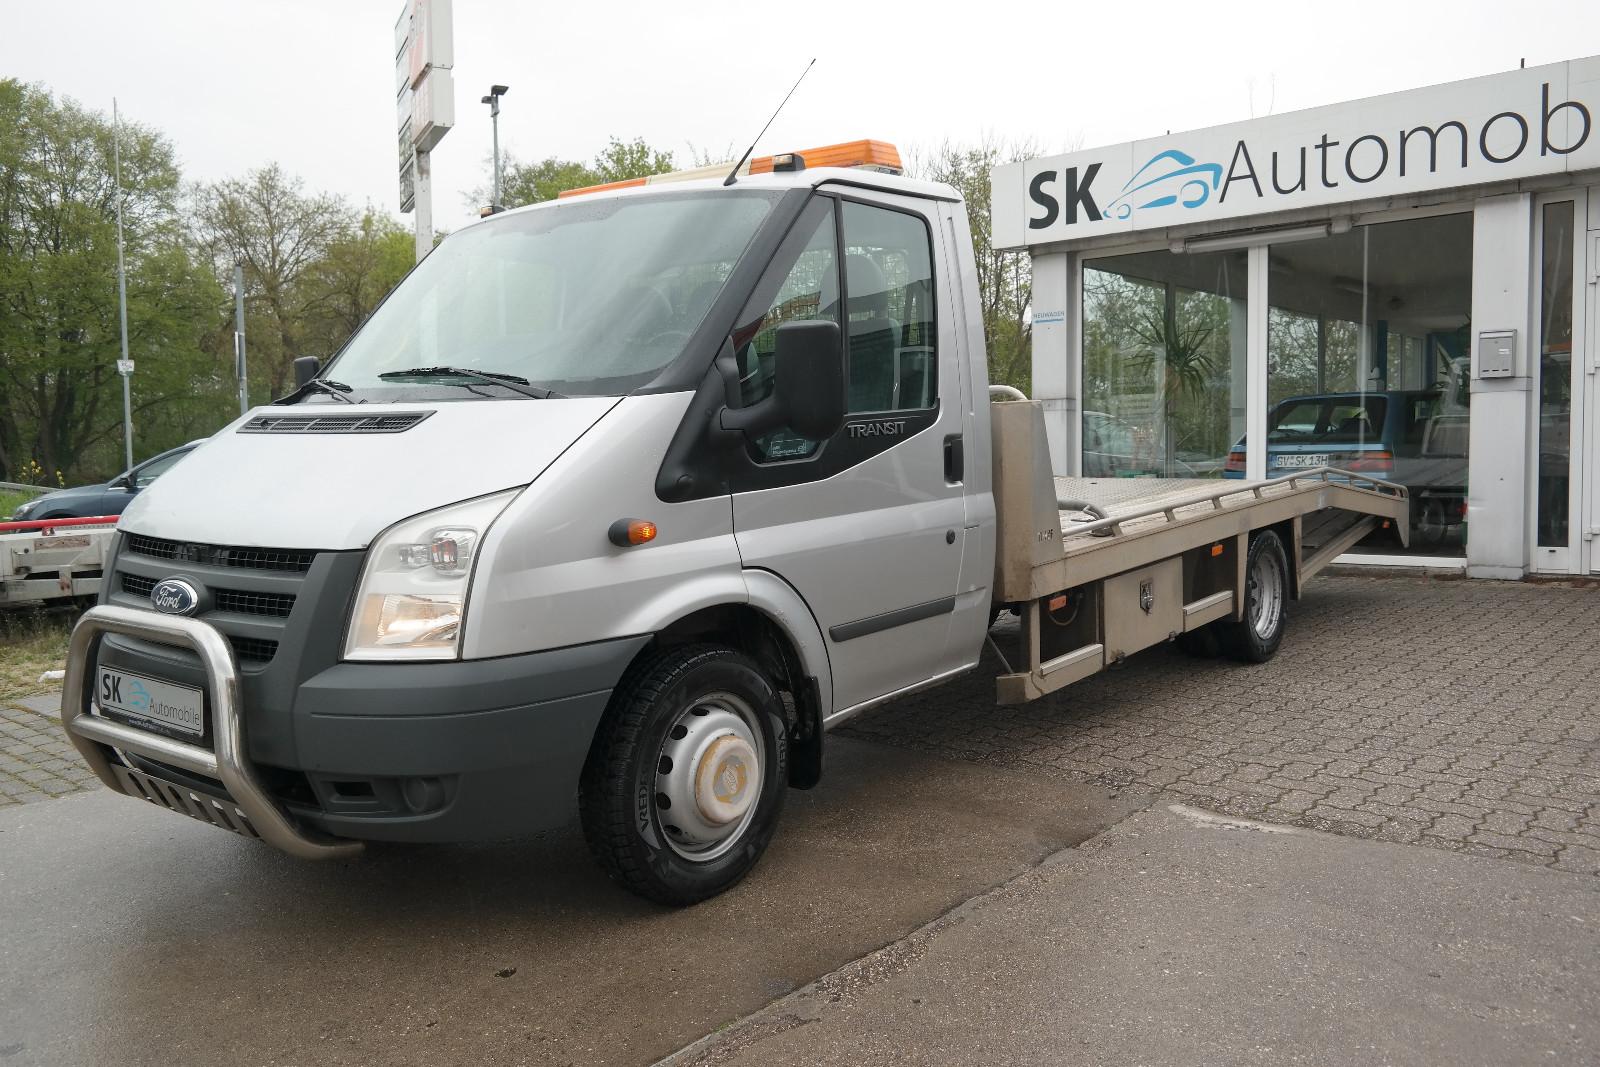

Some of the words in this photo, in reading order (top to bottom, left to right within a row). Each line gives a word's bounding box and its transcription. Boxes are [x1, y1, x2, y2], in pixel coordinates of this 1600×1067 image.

[1028, 162, 1103, 230] SK
[1219, 82, 1592, 204] Automob
[1033, 311, 1065, 319] NEUWAGEN
[847, 421, 906, 438] TRANSIT
[155, 585, 182, 610] Ford
[102, 673, 122, 703] SK
[149, 697, 200, 726] Automobile
